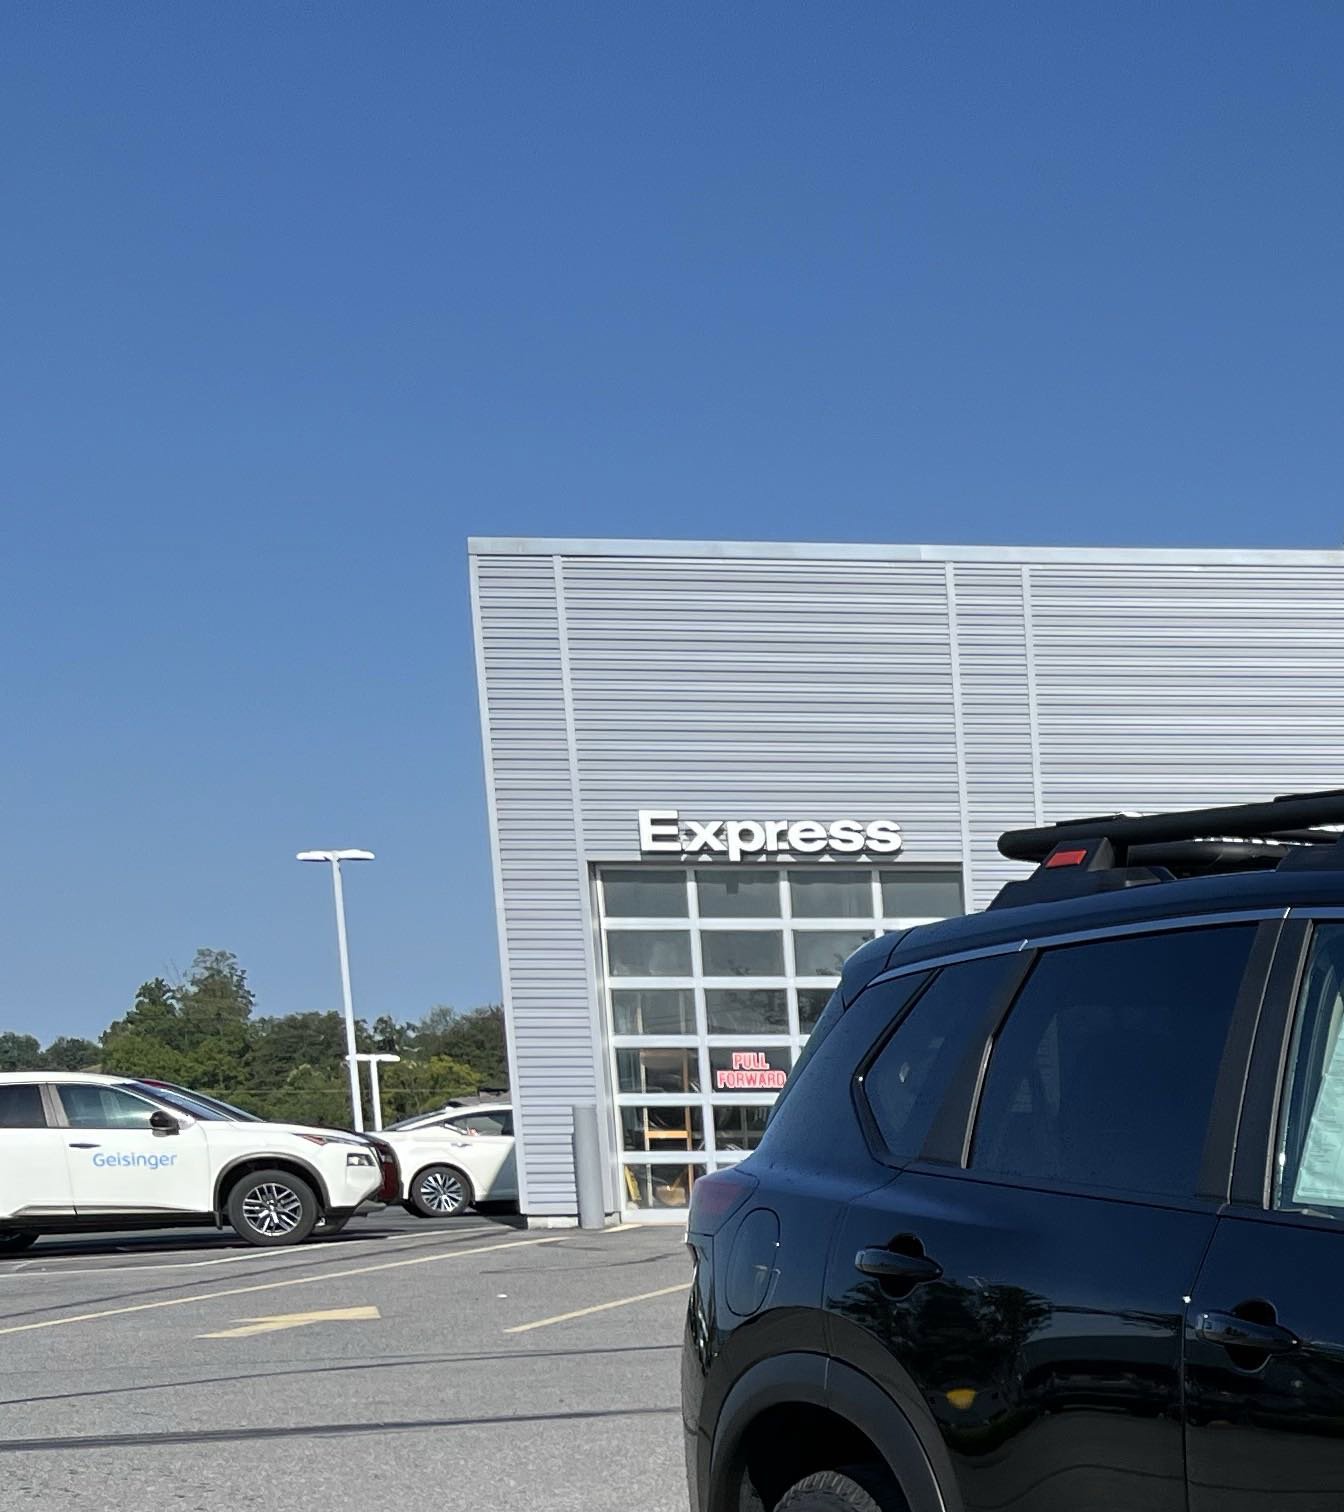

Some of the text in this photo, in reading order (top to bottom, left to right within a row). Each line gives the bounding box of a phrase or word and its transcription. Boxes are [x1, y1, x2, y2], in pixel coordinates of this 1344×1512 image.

[638, 809, 902, 862] Express
[732, 1052, 770, 1070] PULL
[717, 1070, 787, 1088] FORWARD
[92, 1152, 177, 1170] Geisinger
